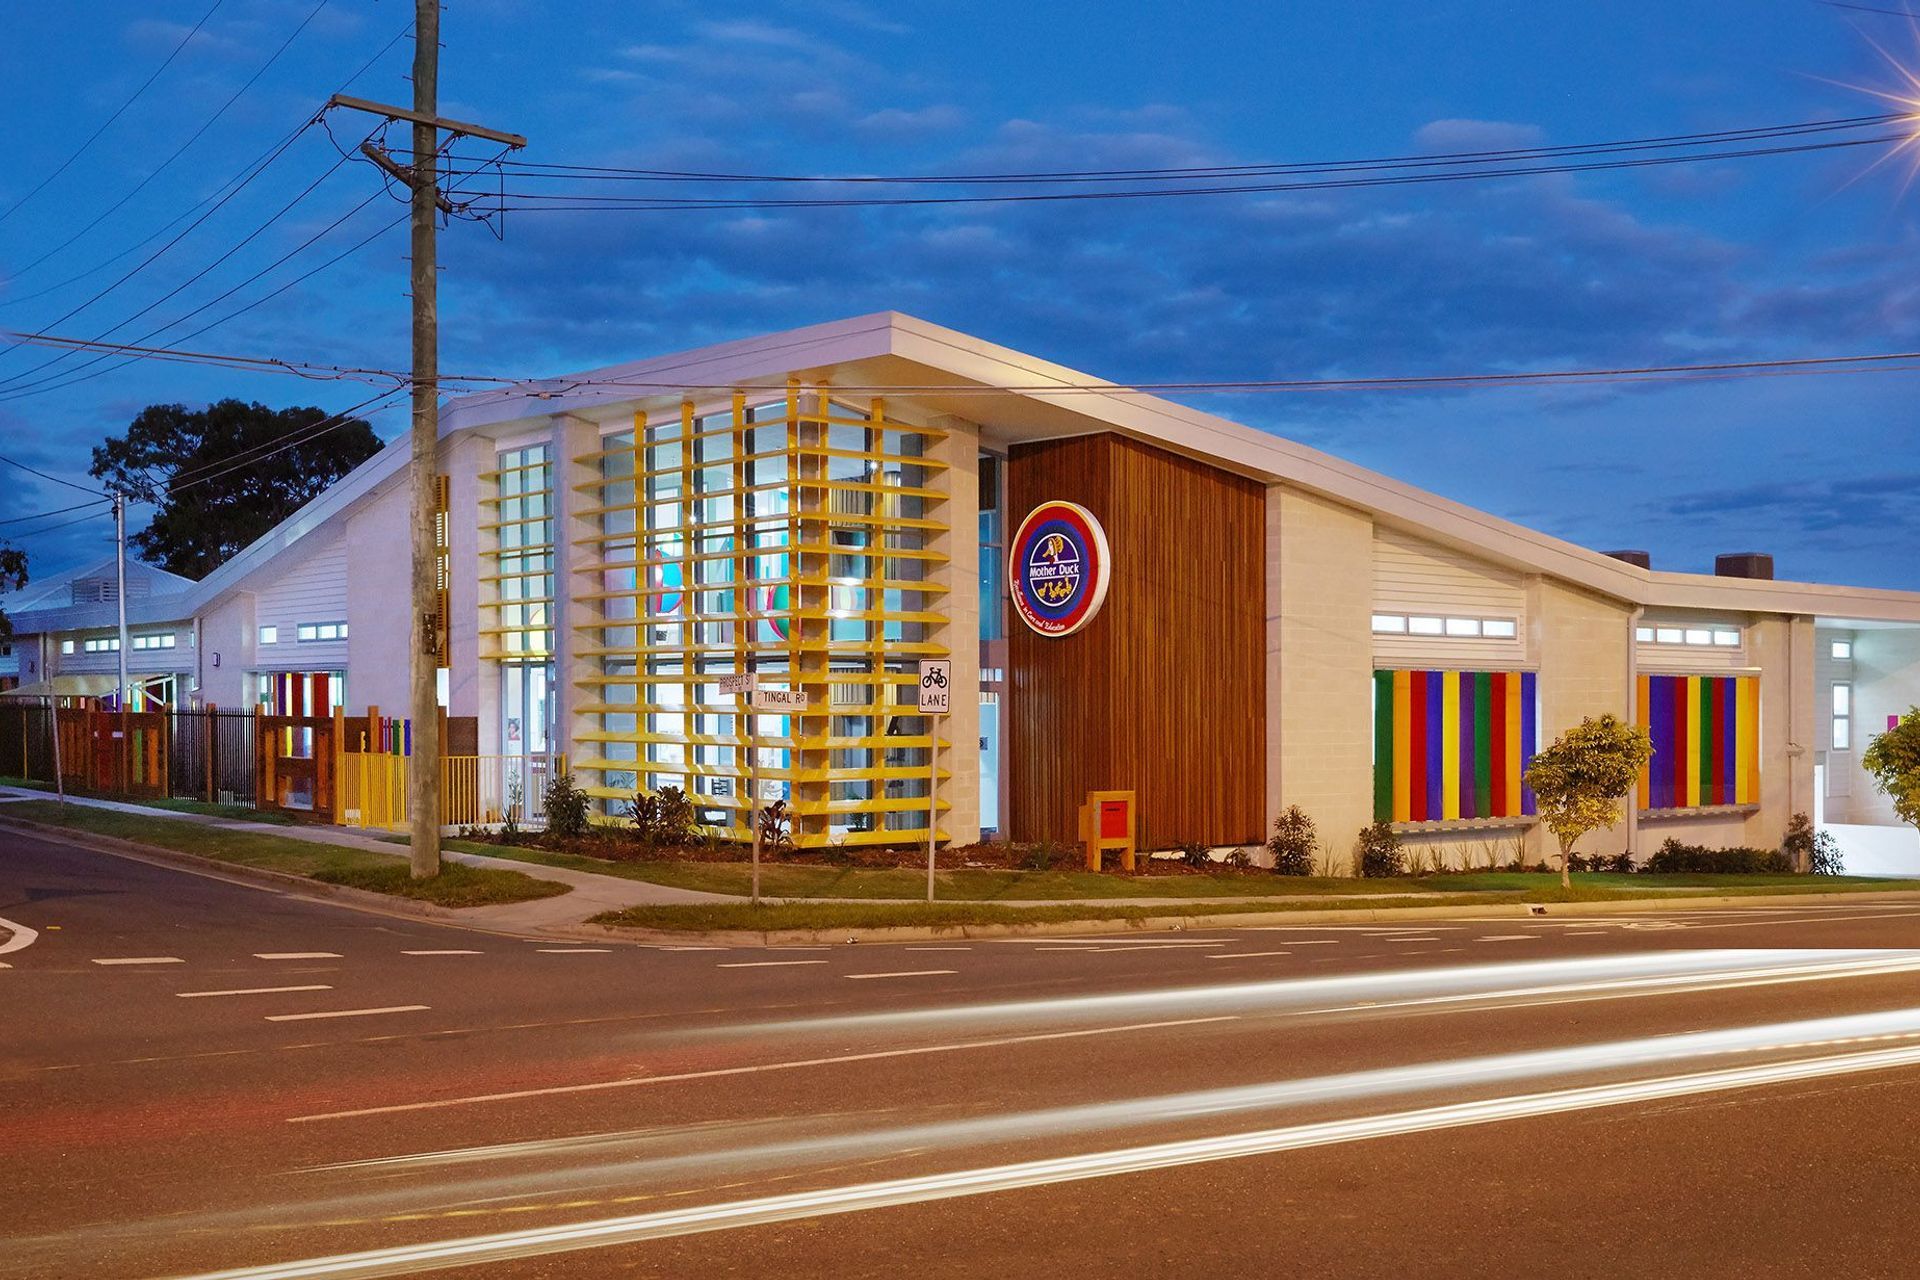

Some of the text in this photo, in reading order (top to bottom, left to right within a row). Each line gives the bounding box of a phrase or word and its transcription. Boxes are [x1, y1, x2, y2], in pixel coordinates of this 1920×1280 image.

[1030, 564, 1079, 577] Mother Duck
[719, 675, 744, 688] PROSPECT
[764, 691, 805, 704] TINGAL RD
[921, 694, 947, 706] LANE
